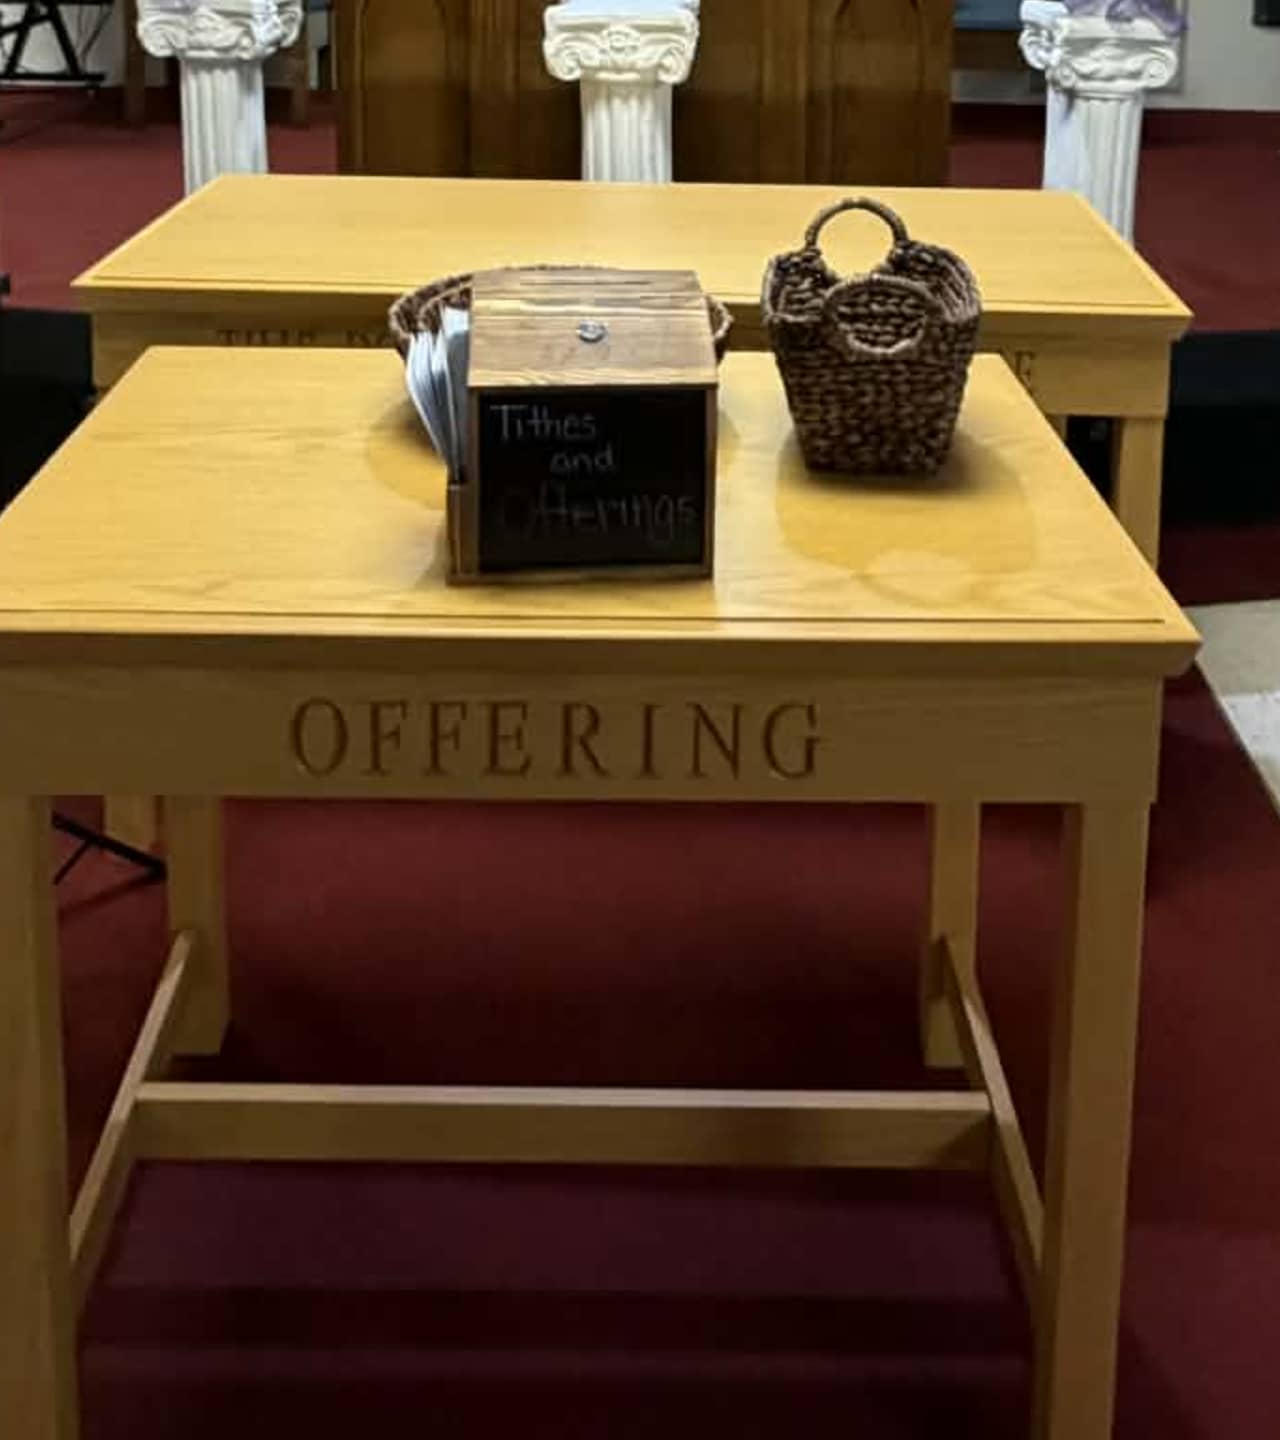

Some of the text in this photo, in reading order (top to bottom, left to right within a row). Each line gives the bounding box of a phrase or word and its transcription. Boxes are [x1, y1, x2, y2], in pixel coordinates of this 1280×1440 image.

[489, 404, 597, 442] Tithes
[550, 442, 616, 477] and
[289, 696, 830, 780] OFFERING
